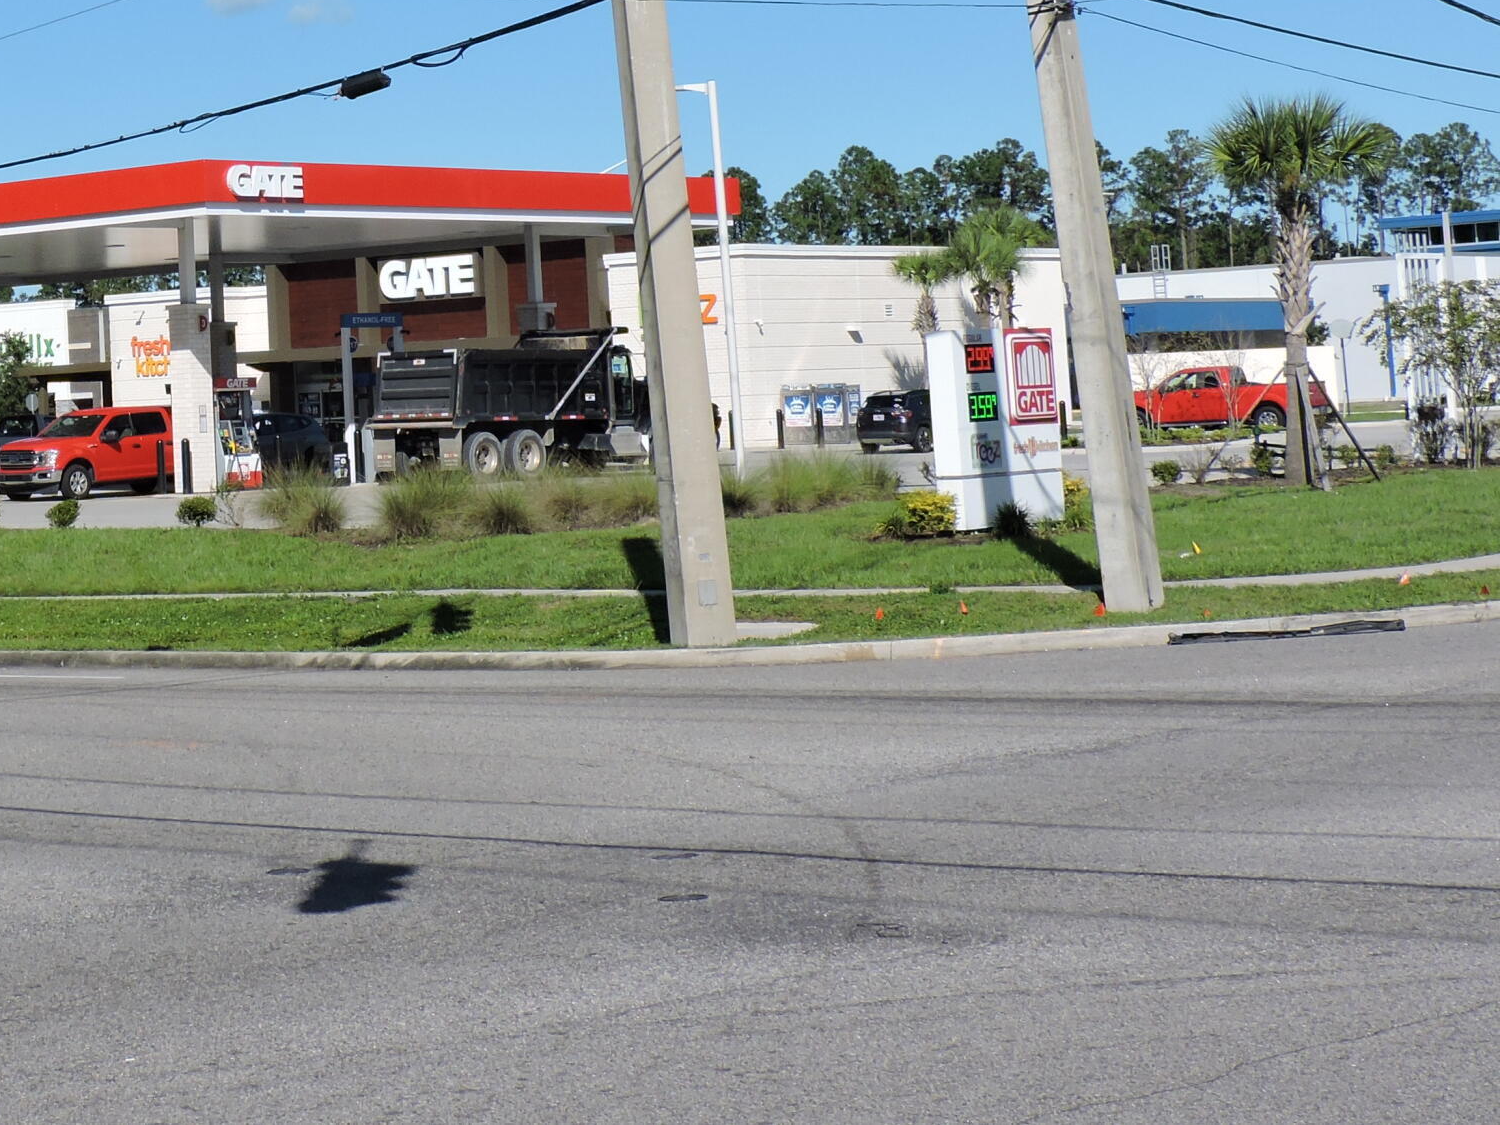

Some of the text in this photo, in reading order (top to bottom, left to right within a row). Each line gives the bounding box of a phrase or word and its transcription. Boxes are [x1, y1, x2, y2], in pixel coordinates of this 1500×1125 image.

[227, 164, 304, 198] GATE
[379, 254, 475, 299] GATE
[352, 316, 396, 324] ETHANOL-FREE
[131, 335, 171, 358] fresh
[227, 378, 249, 388] GATE
[1017, 390, 1055, 413] GATE
